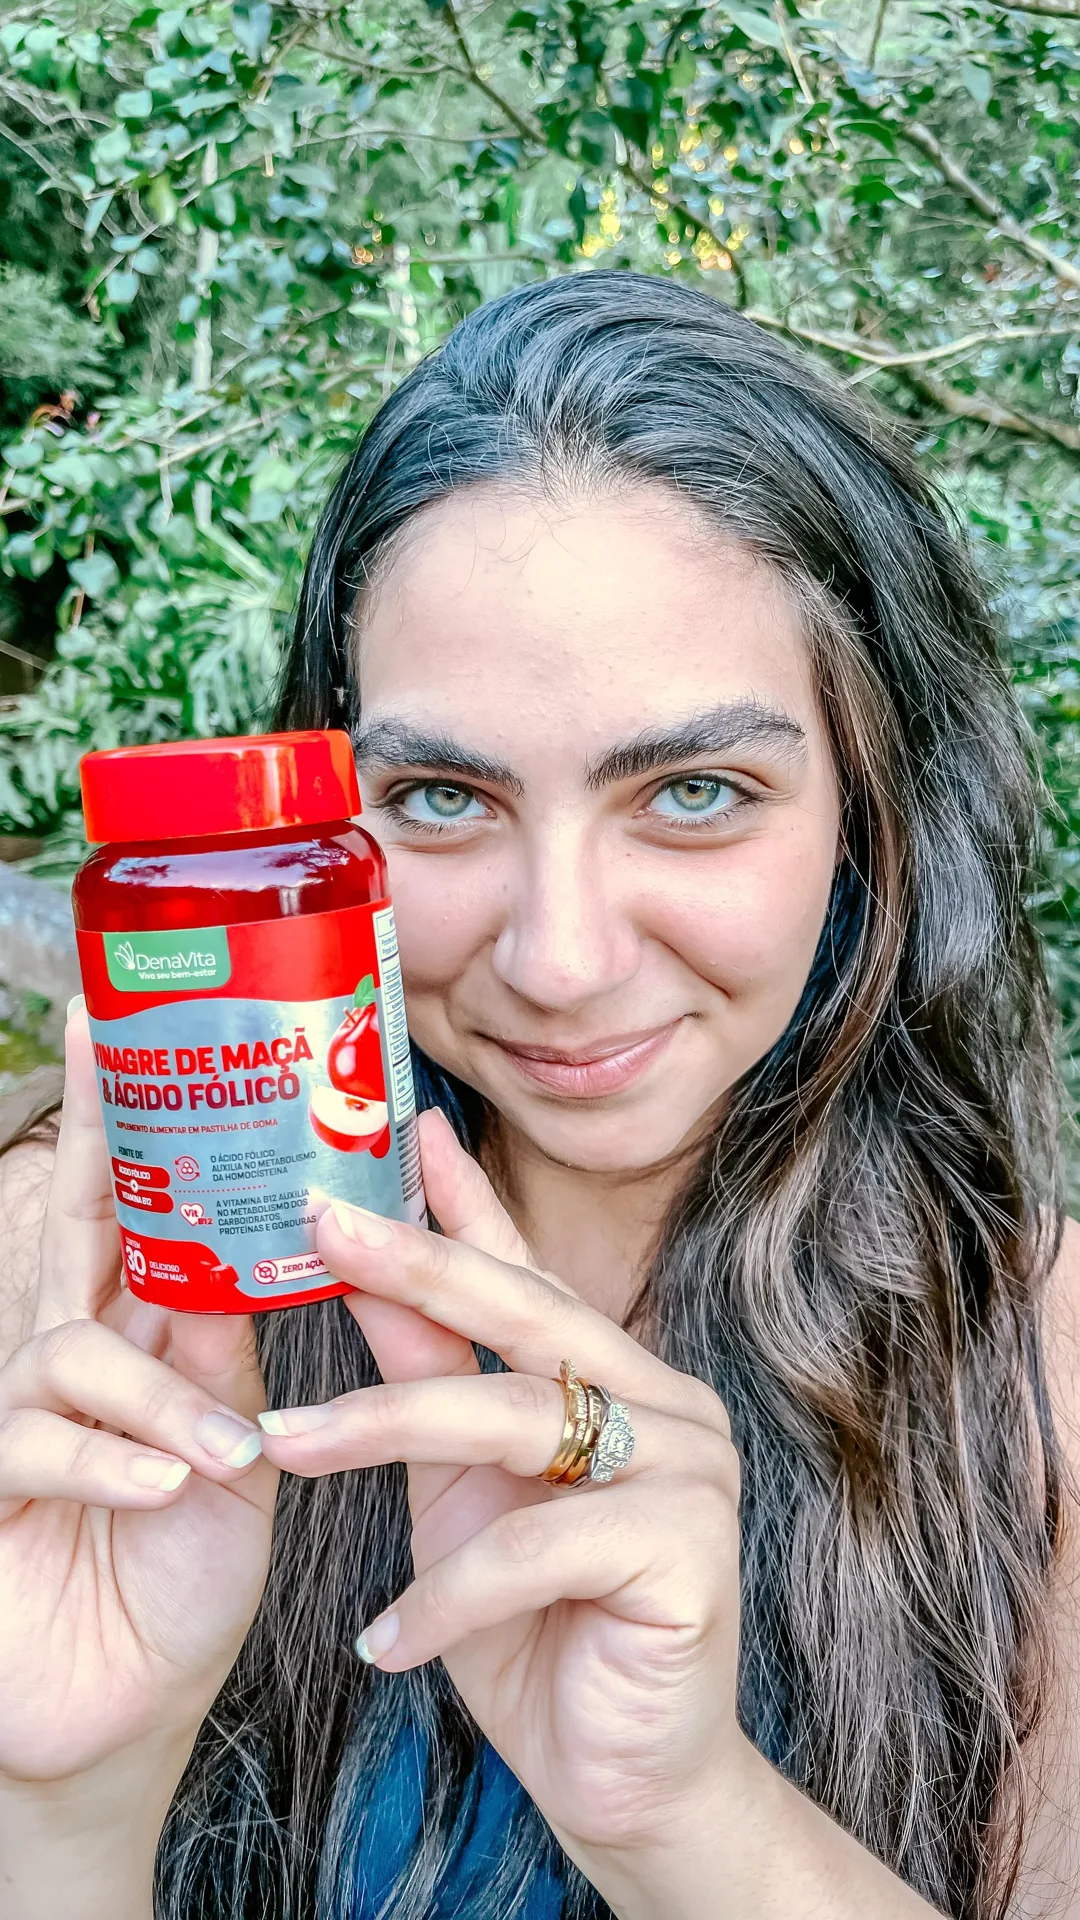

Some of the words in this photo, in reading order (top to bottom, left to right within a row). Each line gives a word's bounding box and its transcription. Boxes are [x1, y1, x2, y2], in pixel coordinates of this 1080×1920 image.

[136, 952, 216, 970] DenaVita
[171, 969, 217, 978] bem-estar
[93, 1041, 171, 1076] VINAGRE
[175, 1047, 216, 1075] DE
[220, 1027, 314, 1074] MAÇÃ
[102, 1077, 113, 1105] &
[114, 1074, 183, 1111] ÁCIDO
[188, 1072, 299, 1111] FÓLICO
[149, 1126, 187, 1134] ALIMENTAR
[188, 1126, 200, 1134] EM
[201, 1123, 239, 1133] PASTILHA
[240, 1122, 252, 1130] DE
[253, 1119, 278, 1129] GOMA
[118, 1145, 134, 1158] FONTE
[135, 1150, 144, 1159] DE
[210, 1154, 217, 1163] O
[219, 1152, 243, 1162] ÁCIDO
[245, 1149, 275, 1160] FÓLICO
[212, 1161, 242, 1172] AUXILIA
[244, 1161, 256, 1169] NO
[258, 1151, 317, 1167] METABOLISMO
[213, 1173, 224, 1182] DA
[216, 1200, 222, 1208] A
[223, 1197, 261, 1207] VITAMINA
[263, 1194, 277, 1203] B12
[278, 1188, 310, 1201] AUXILIA
[184, 1209, 199, 1218] Vit
[217, 1209, 229, 1217] NO
[230, 1202, 290, 1216] METABOLISMO
[291, 1198, 308, 1208] DOS
[218, 1213, 282, 1226] CARBOIDRATOS,
[219, 1224, 264, 1235] PROTEÍNAS
[272, 1215, 317, 1230] GORDURAS
[125, 1245, 147, 1276] 30
[149, 1260, 180, 1273] DELICIOSO
[282, 1263, 303, 1274] ZERO
[305, 1257, 325, 1270] AÇÚ
[150, 1269, 169, 1280] SABOR
